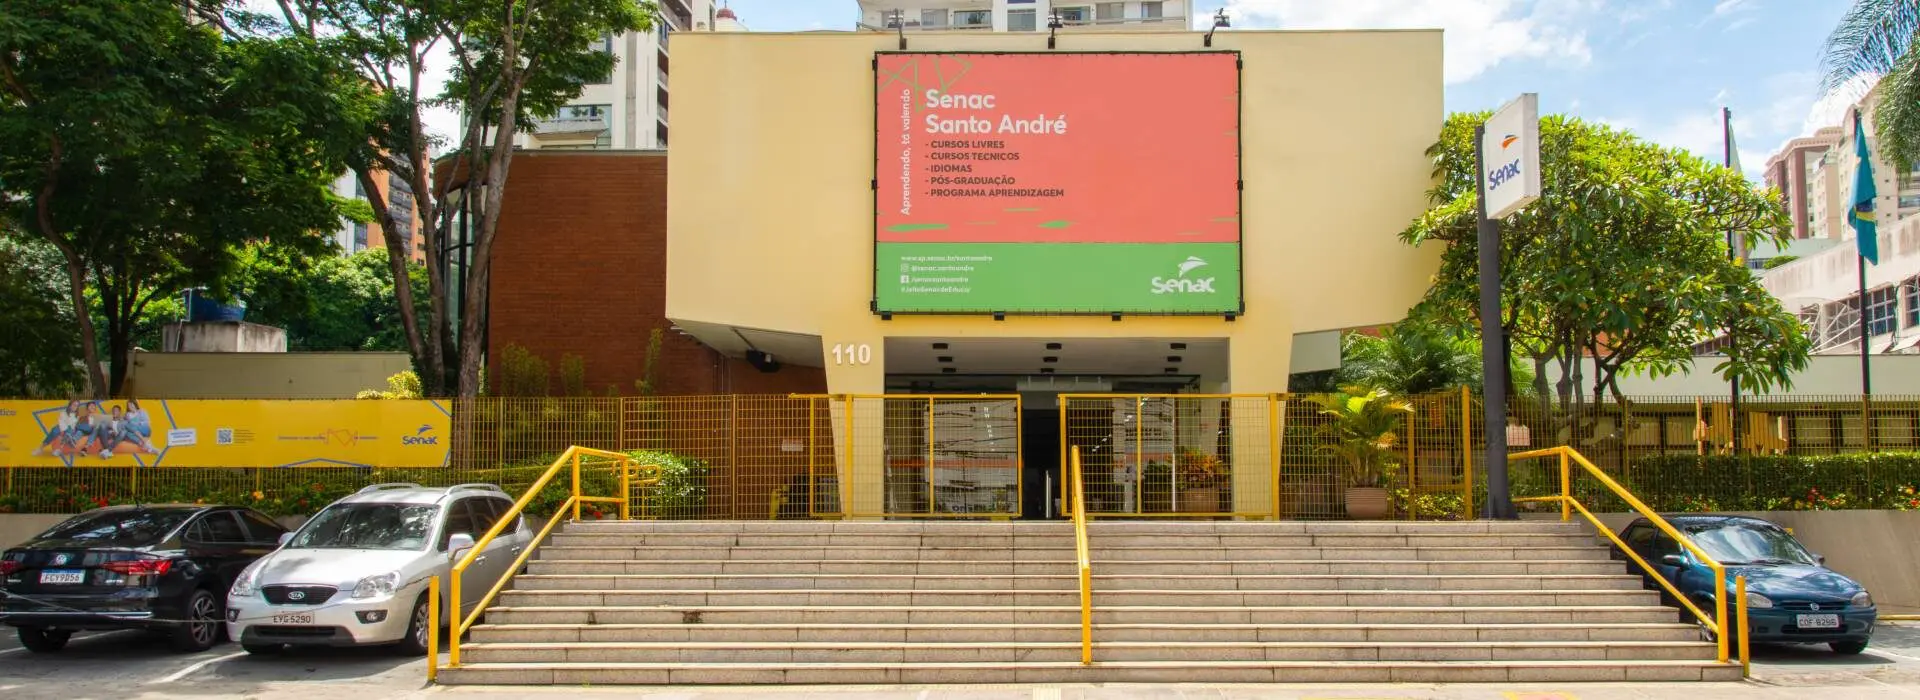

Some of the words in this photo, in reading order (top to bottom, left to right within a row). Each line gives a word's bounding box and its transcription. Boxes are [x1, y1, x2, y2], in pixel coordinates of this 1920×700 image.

[925, 88, 996, 109] Senac
[900, 88, 910, 131] valendo
[925, 113, 992, 134] Santo
[998, 113, 1067, 134] André
[930, 140, 970, 149] CURSOS
[972, 140, 1005, 149] LIVRES
[930, 152, 970, 161] CURSOS
[930, 164, 973, 173] IDIOMAS
[1489, 158, 1520, 190] Senac
[900, 147, 912, 216] Aprendendo,
[930, 175, 1016, 187] PÓS-GRADUAÇÃO
[930, 188, 986, 197] PROGRAMA
[988, 188, 1065, 197] APRENDIZAGEM
[1151, 276, 1216, 294] Senac
[832, 343, 871, 365] 110
[402, 435, 438, 445] Senac
